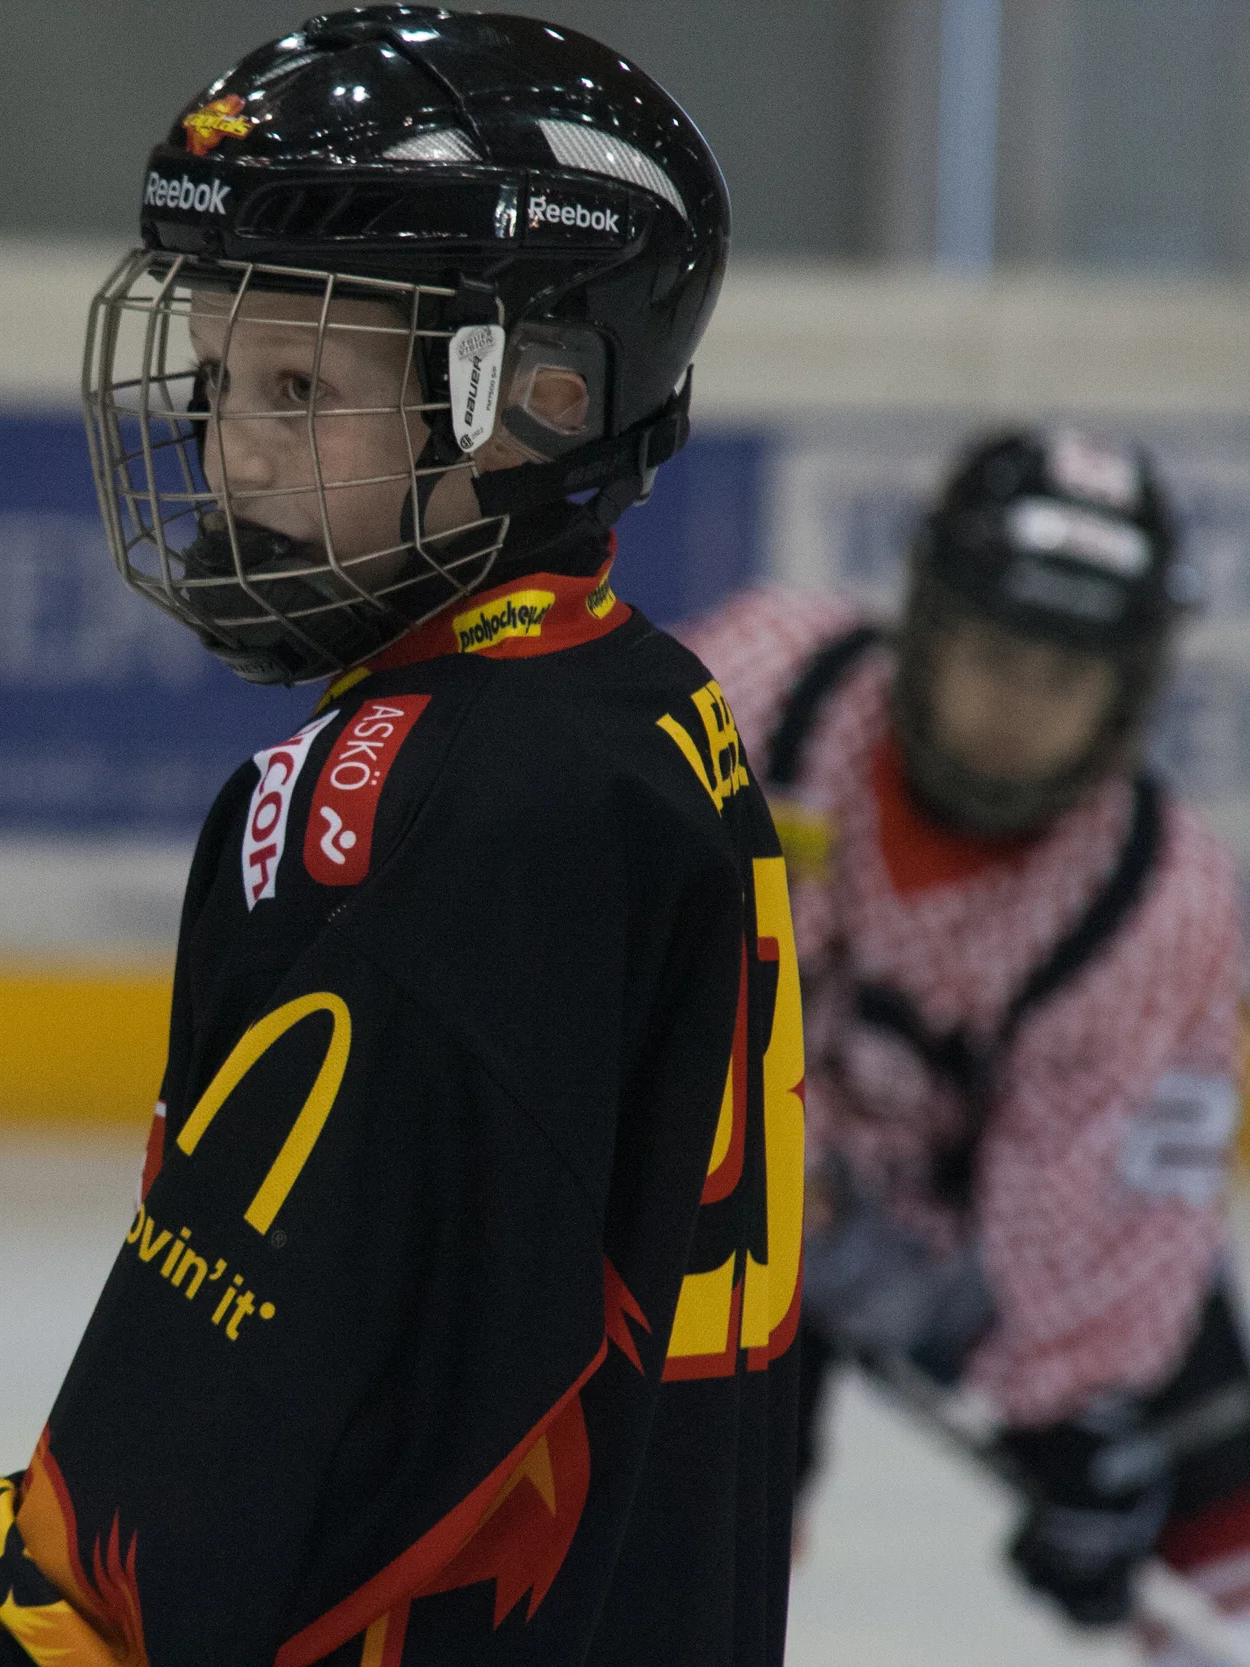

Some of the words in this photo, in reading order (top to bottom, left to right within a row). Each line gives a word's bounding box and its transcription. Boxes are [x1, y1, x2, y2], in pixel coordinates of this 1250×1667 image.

[145, 171, 232, 215] Reebok
[529, 196, 620, 234] Reebok
[464, 355, 483, 427] BAUER
[329, 704, 405, 791] ASKÖ
